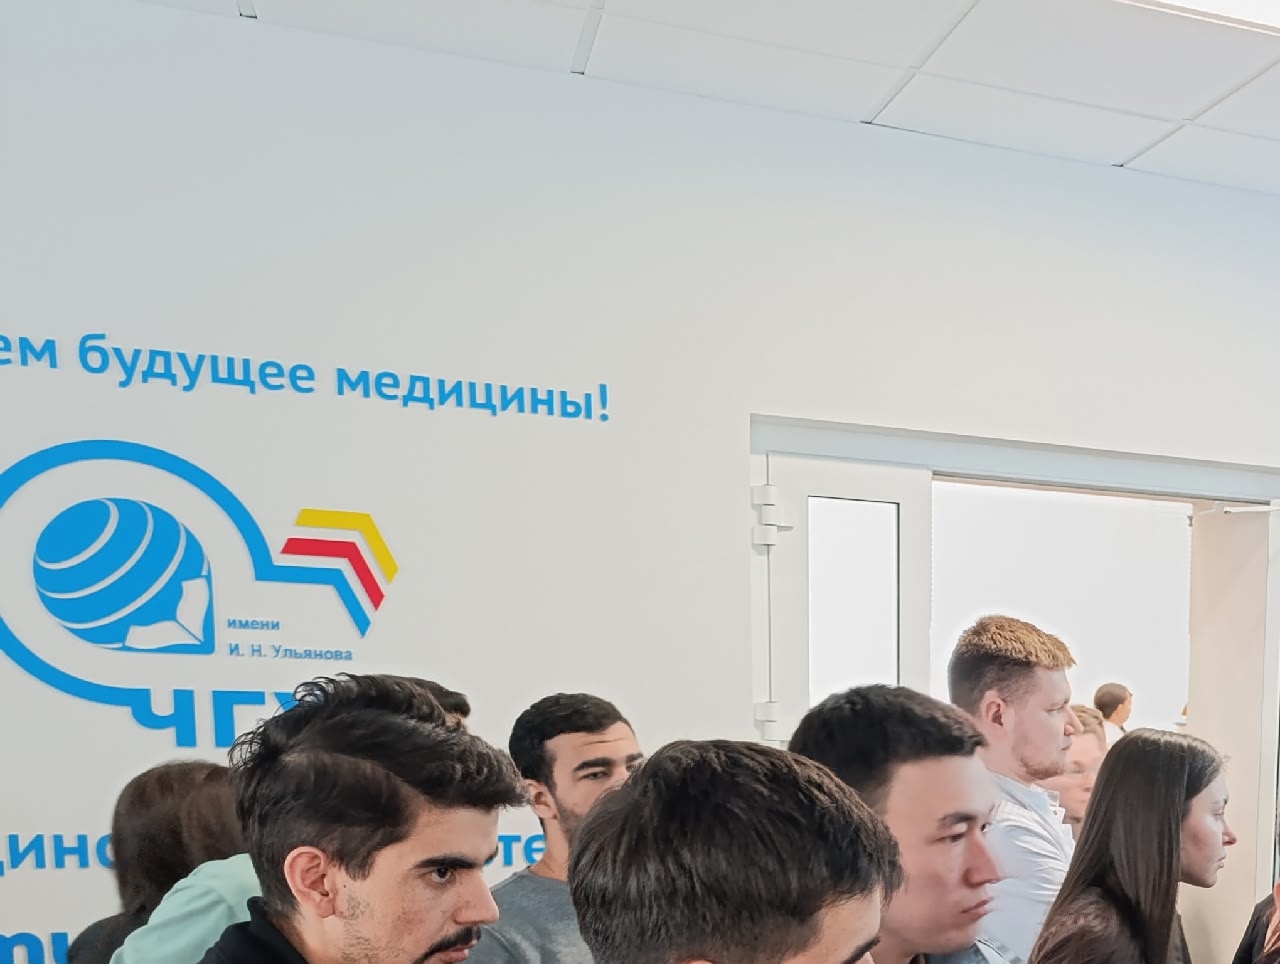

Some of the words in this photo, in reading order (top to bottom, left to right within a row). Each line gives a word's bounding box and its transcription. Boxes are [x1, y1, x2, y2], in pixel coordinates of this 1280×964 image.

[0, 333, 59, 369] ем
[78, 332, 315, 394] будущее
[336, 366, 610, 422] медицины!
[227, 618, 280, 631] имени
[229, 643, 244, 656] И.
[250, 644, 267, 657] Н.
[271, 645, 353, 660] Ульянова
[131, 687, 305, 748] ЧГ
